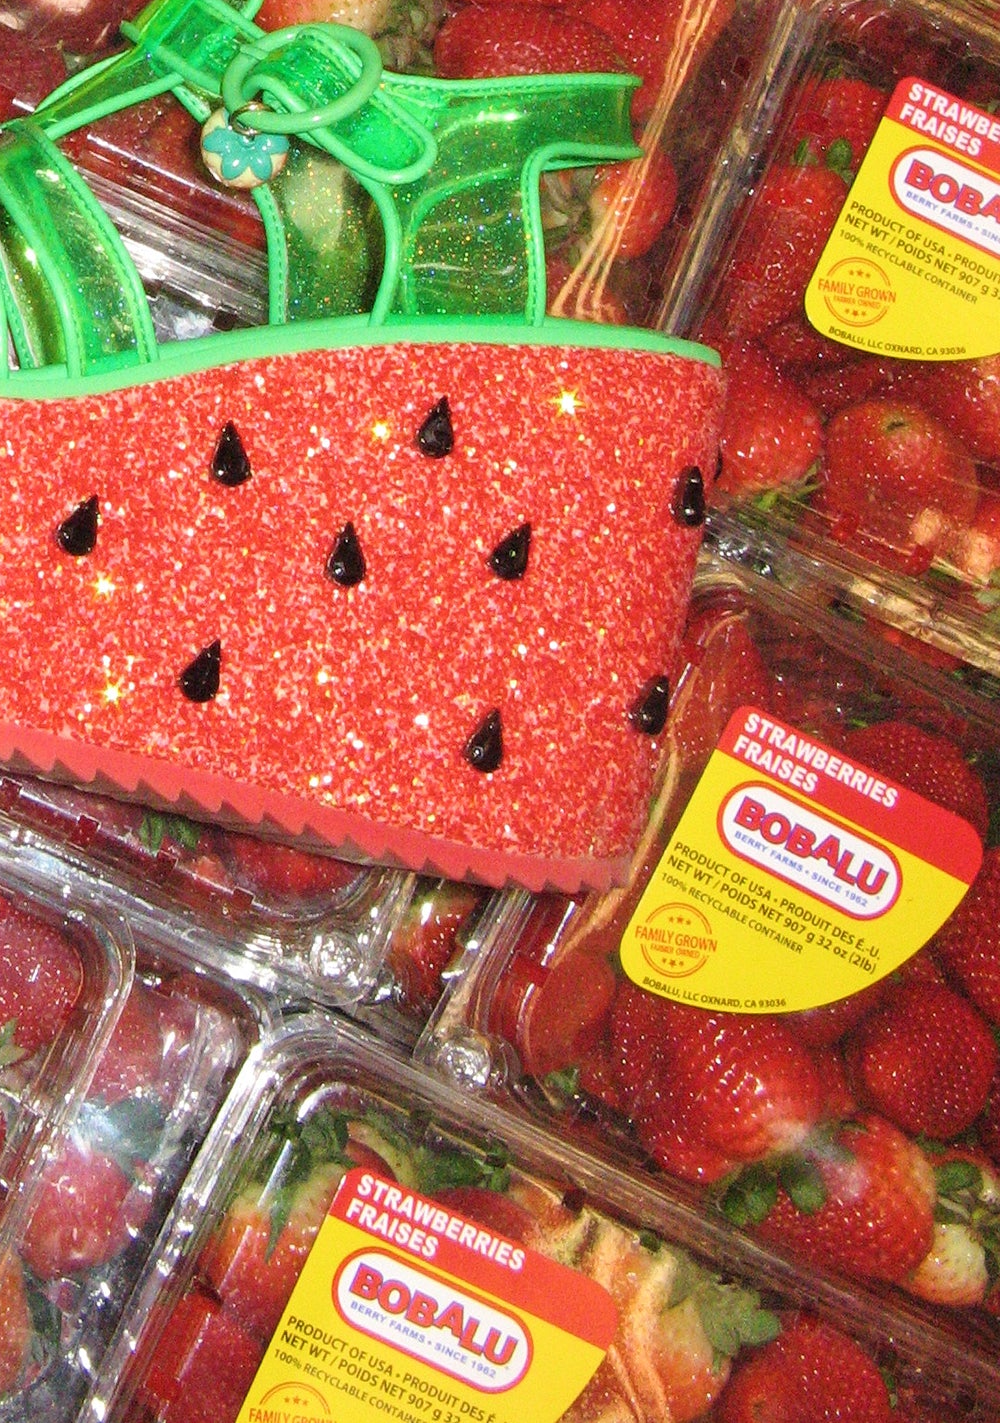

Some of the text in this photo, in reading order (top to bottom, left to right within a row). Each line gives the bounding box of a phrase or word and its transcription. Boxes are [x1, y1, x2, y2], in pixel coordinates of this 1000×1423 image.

[899, 102, 981, 156] FRAISES
[908, 83, 1000, 144] STRAWBE
[850, 201, 905, 234] PRODUCT
[905, 229, 921, 242] OF
[922, 237, 945, 256] USA
[903, 158, 1000, 225] BOBA
[844, 213, 869, 231] NET
[870, 225, 889, 241] WT
[895, 239, 932, 264] POIDS
[933, 258, 957, 276] NET
[958, 270, 980, 287] 907
[980, 284, 989, 295] g
[732, 734, 818, 792] FRAISES
[744, 712, 898, 807] STRAWBERRIES
[733, 795, 888, 895] BOBALU
[734, 829, 867, 906] BERRY FARMS SINCE 1962
[661, 871, 803, 953] 100% RECYCLABLE CONTAINER
[667, 855, 693, 874] NET
[693, 868, 714, 885] WT
[719, 883, 758, 910] POIDS
[758, 903, 783, 923] NET
[783, 917, 807, 935] 907
[805, 932, 815, 944] g
[816, 935, 832, 950] 32
[833, 946, 848, 959] oz
[848, 952, 876, 975] (2lb)
[673, 841, 731, 877] PRODUCT
[730, 872, 747, 886] OF
[748, 881, 771, 902] USA
[779, 898, 832, 932] PRODUIT
[831, 926, 855, 945] DES
[634, 924, 674, 942] FAMILY
[674, 933, 717, 951] GROWN
[346, 1197, 438, 1257] FRAISES
[357, 1174, 525, 1270] STRAWBERRIES
[349, 1263, 518, 1365] BOBALU
[275, 1348, 302, 1369] 100%
[303, 1362, 368, 1401] RECYCLABLE
[280, 1330, 308, 1350] NET
[309, 1343, 330, 1361] WT
[337, 1358, 378, 1386] POIDS
[379, 1379, 406, 1399] NET
[407, 1393, 432, 1412] 907
[431, 1408, 442, 1421] g
[287, 1315, 348, 1352] PRODUCT
[348, 1346, 367, 1361] OF
[367, 1355, 393, 1377] USA
[401, 1372, 459, 1407] PRODUIT
[459, 1401, 485, 1421] DES
